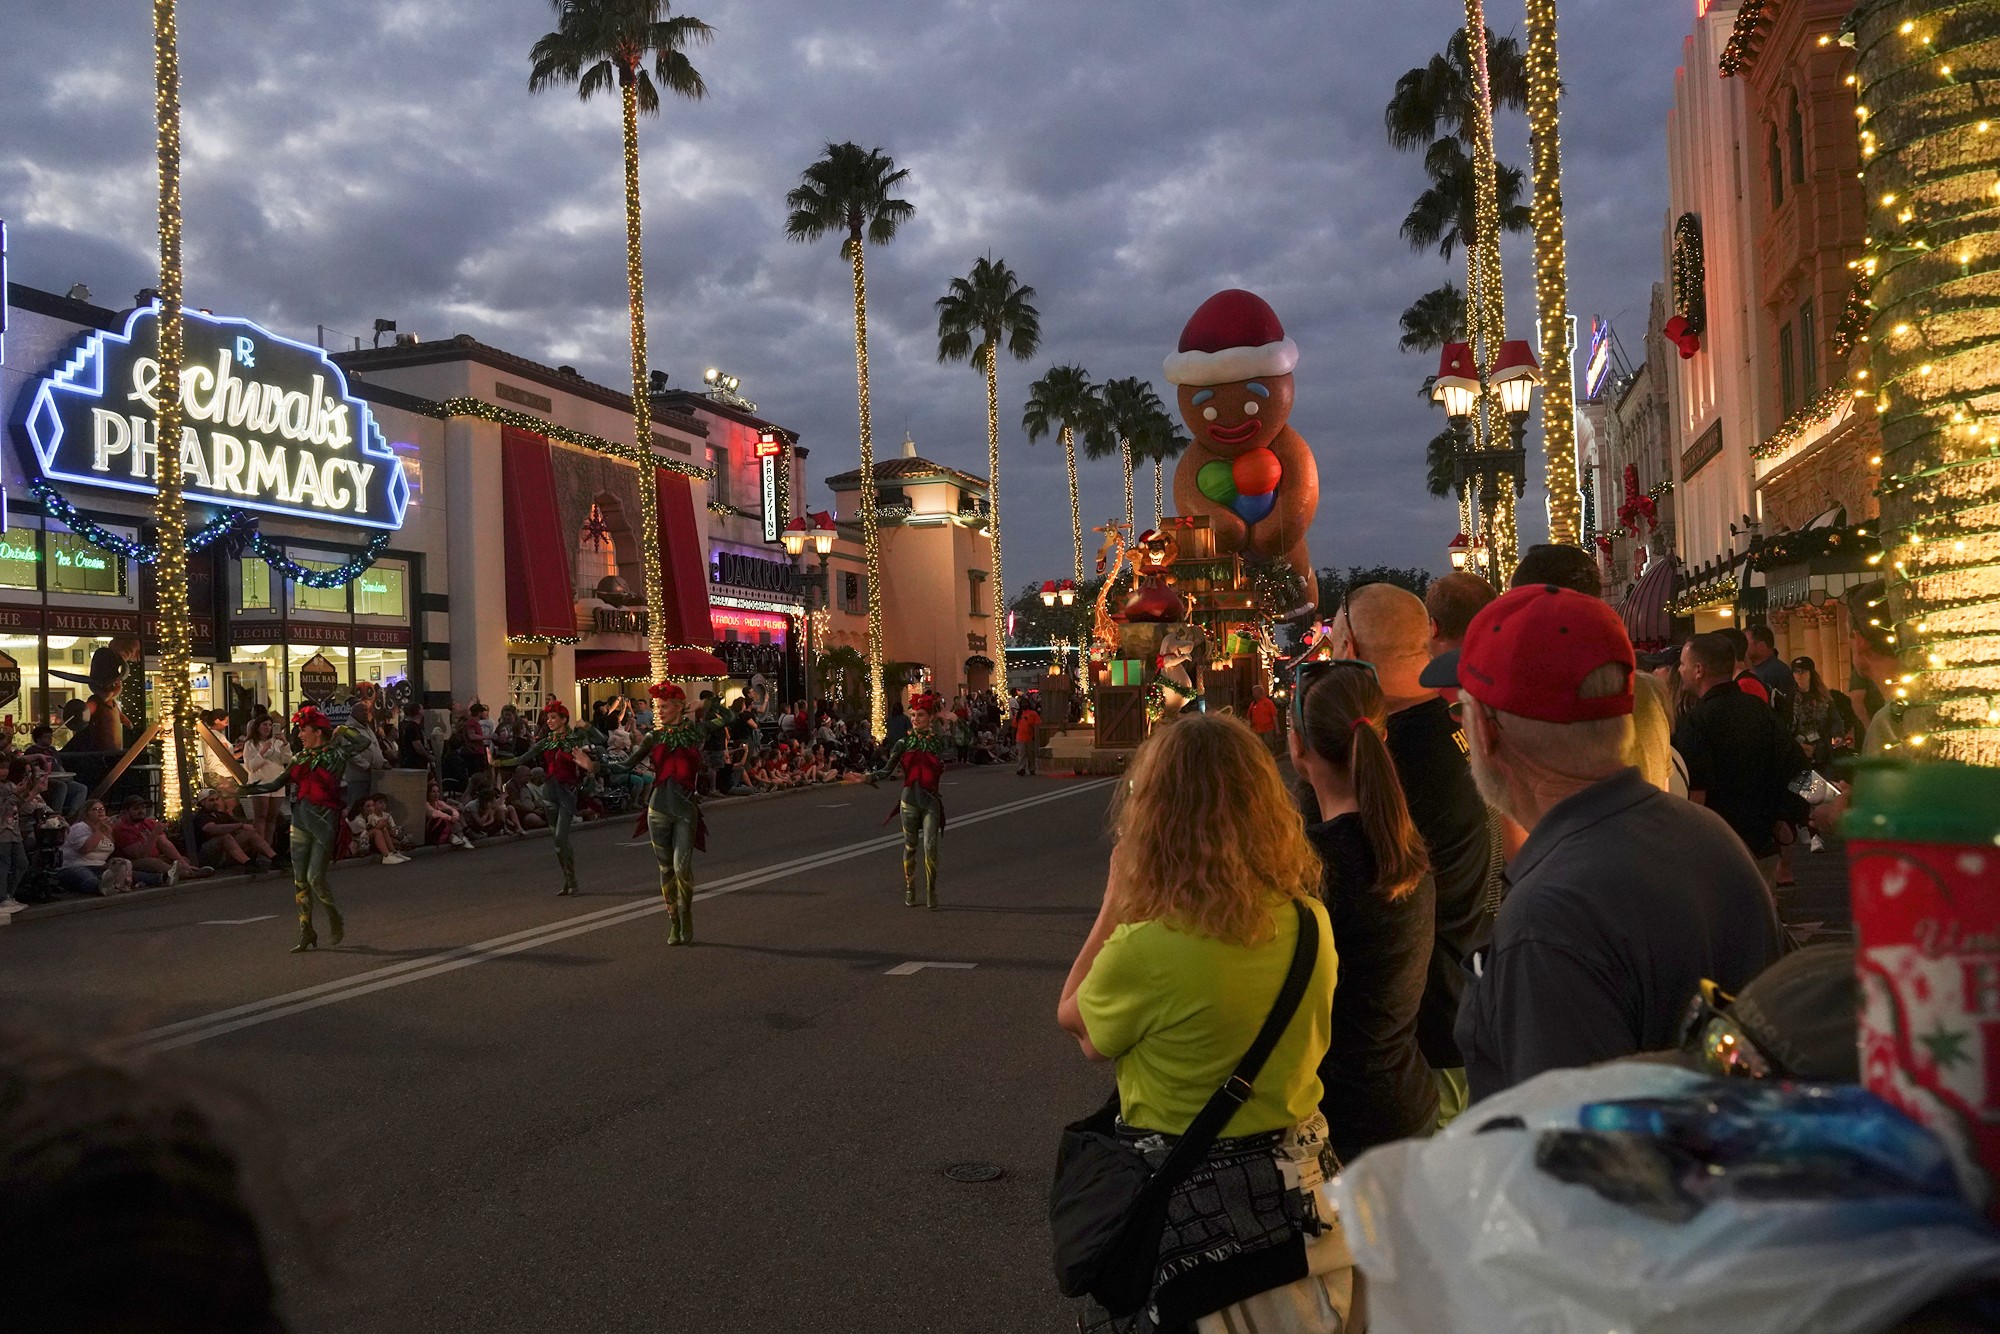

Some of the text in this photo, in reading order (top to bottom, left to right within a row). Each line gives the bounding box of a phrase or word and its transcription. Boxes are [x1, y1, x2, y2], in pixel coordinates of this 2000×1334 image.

[127, 347, 353, 451] Schwab's
[90, 406, 375, 514] PHARMACY
[0, 542, 37, 559] Drinks
[55, 550, 106, 570] Ice Cream
[725, 551, 796, 593] DARKROO
[56, 615, 101, 629] MILK
[101, 617, 132, 631] BAR
[715, 615, 740, 627] FAMOUS
[744, 617, 761, 629] PHOTO
[233, 626, 281, 640] LECHE
[293, 627, 346, 641] MILK BAR
[366, 631, 400, 643] LECHE
[302, 674, 336, 683] MILK BAR
[1204, 1242, 1242, 1263] NEWS
